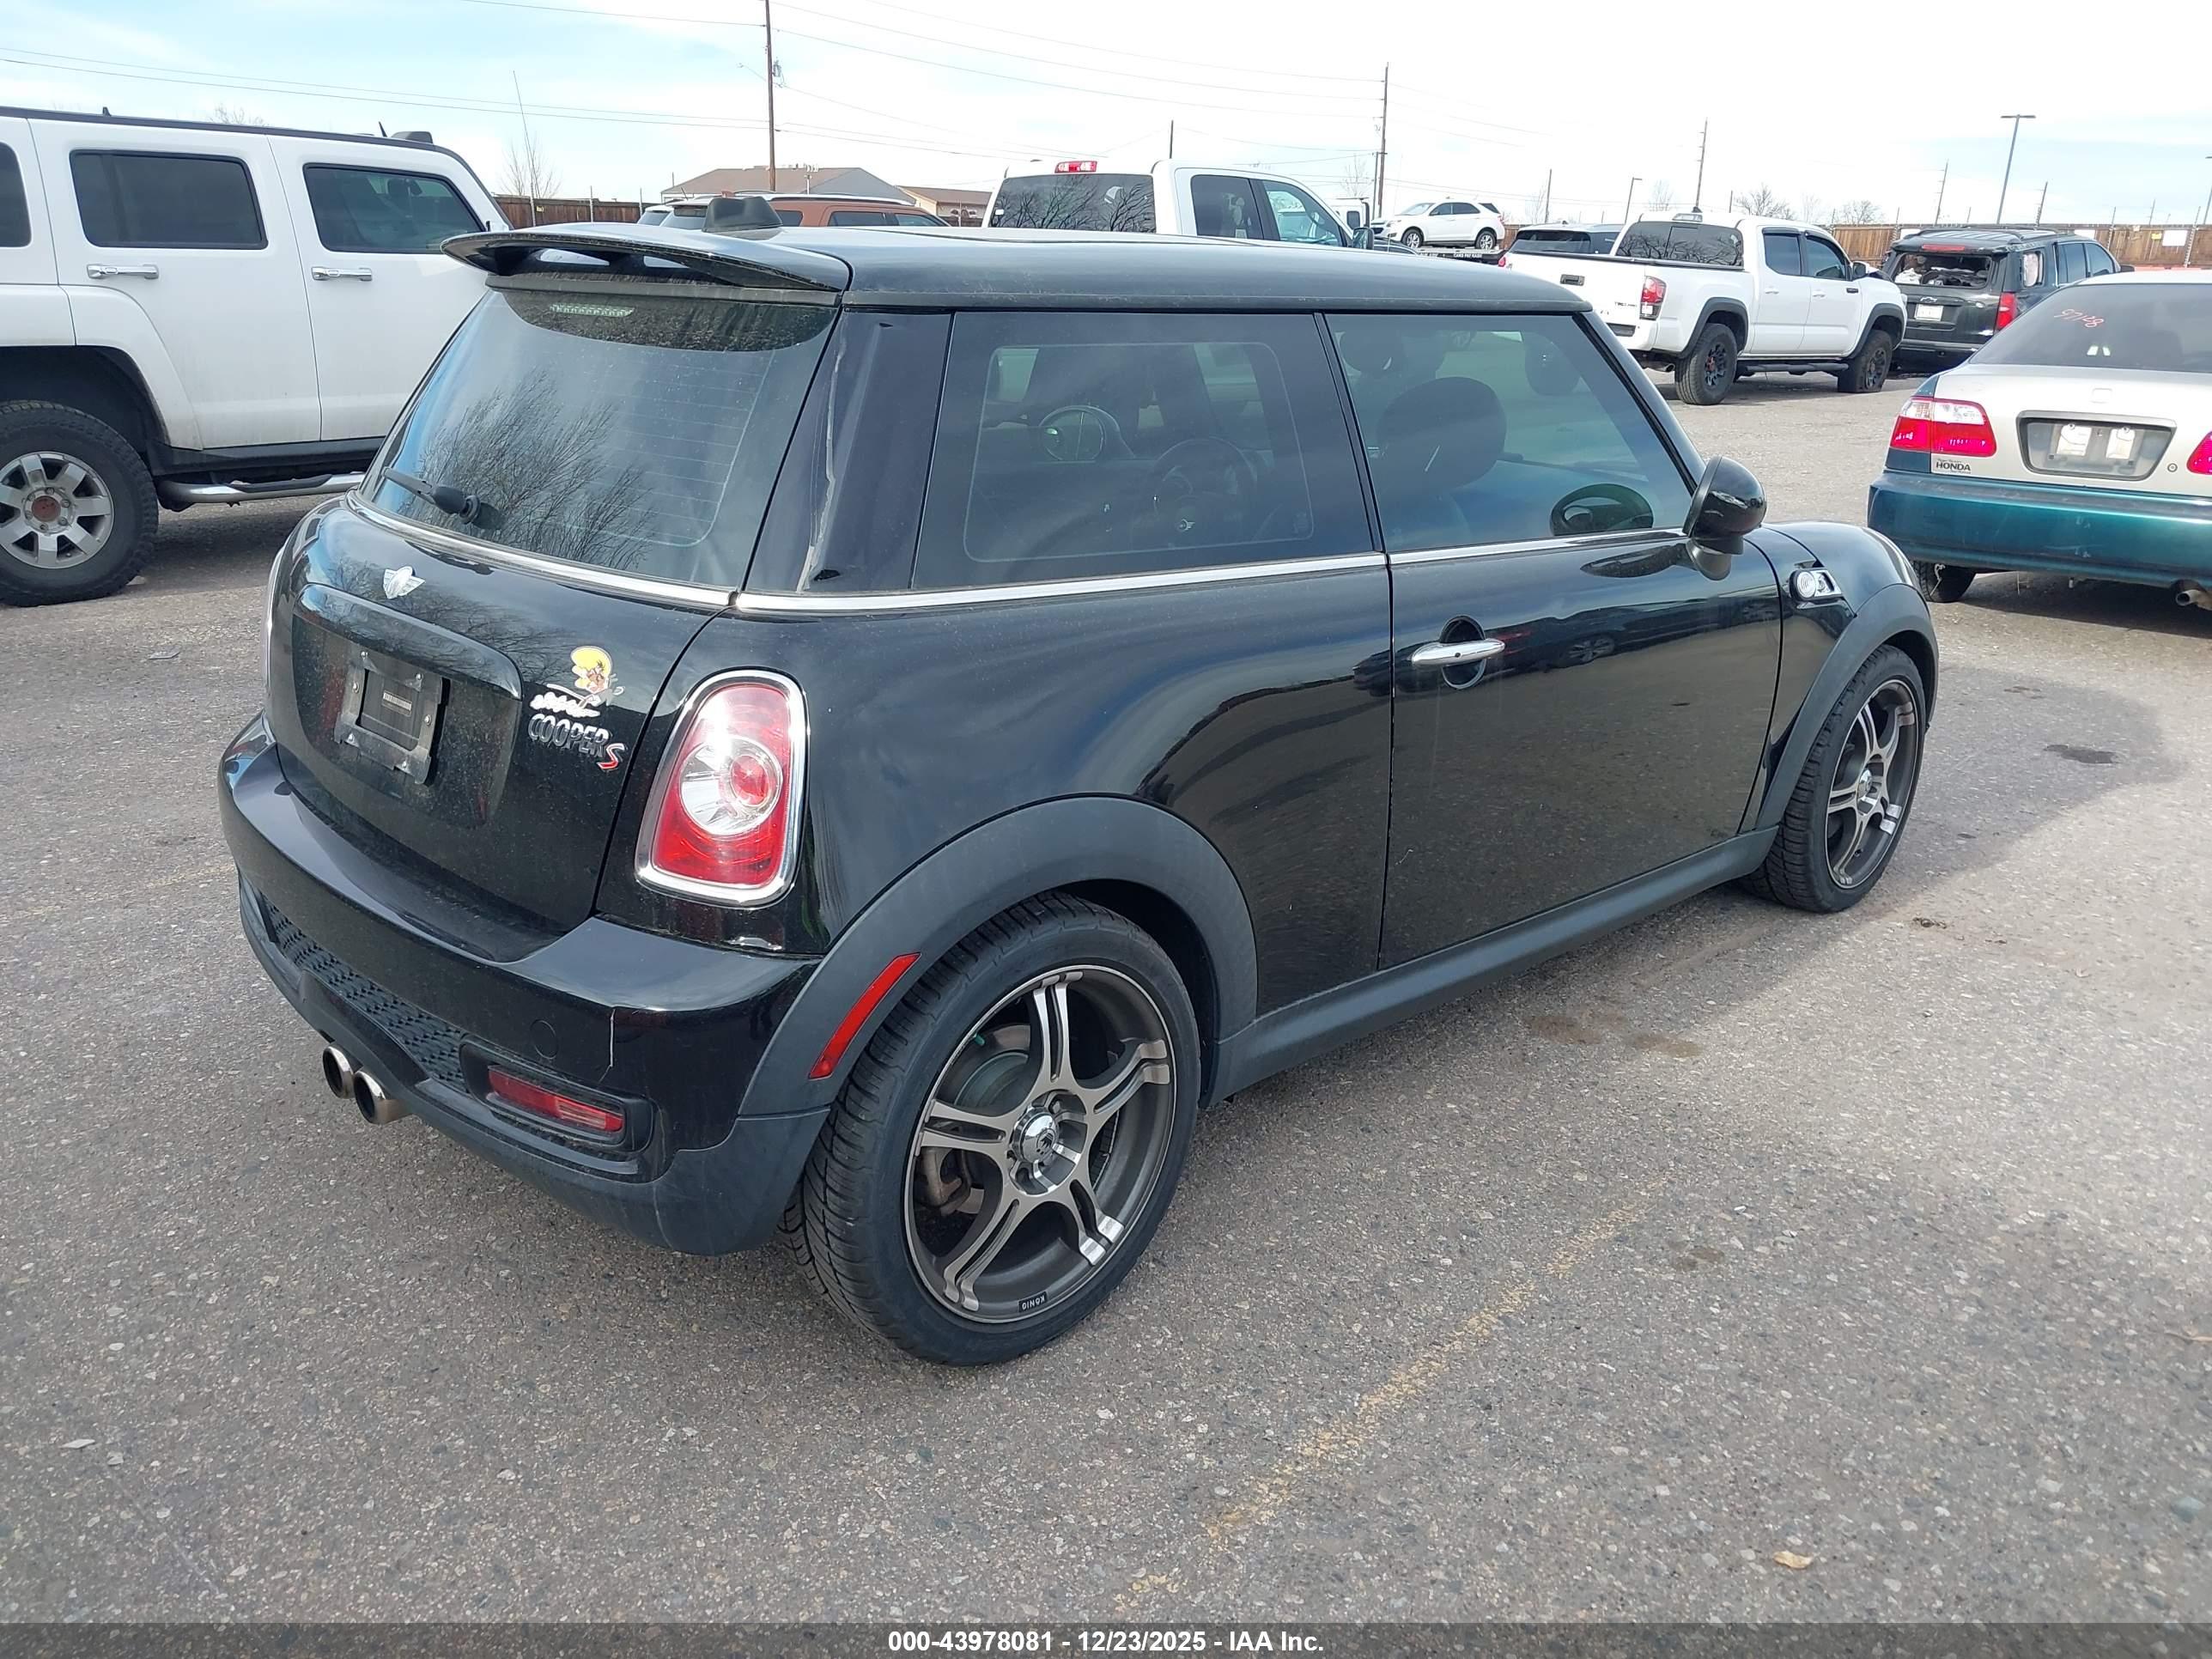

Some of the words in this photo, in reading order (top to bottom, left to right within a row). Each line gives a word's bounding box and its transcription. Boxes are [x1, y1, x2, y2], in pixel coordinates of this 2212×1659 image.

[1936, 462, 1971, 471] HONDA
[528, 714, 611, 757] COOPER
[597, 743, 626, 769] S
